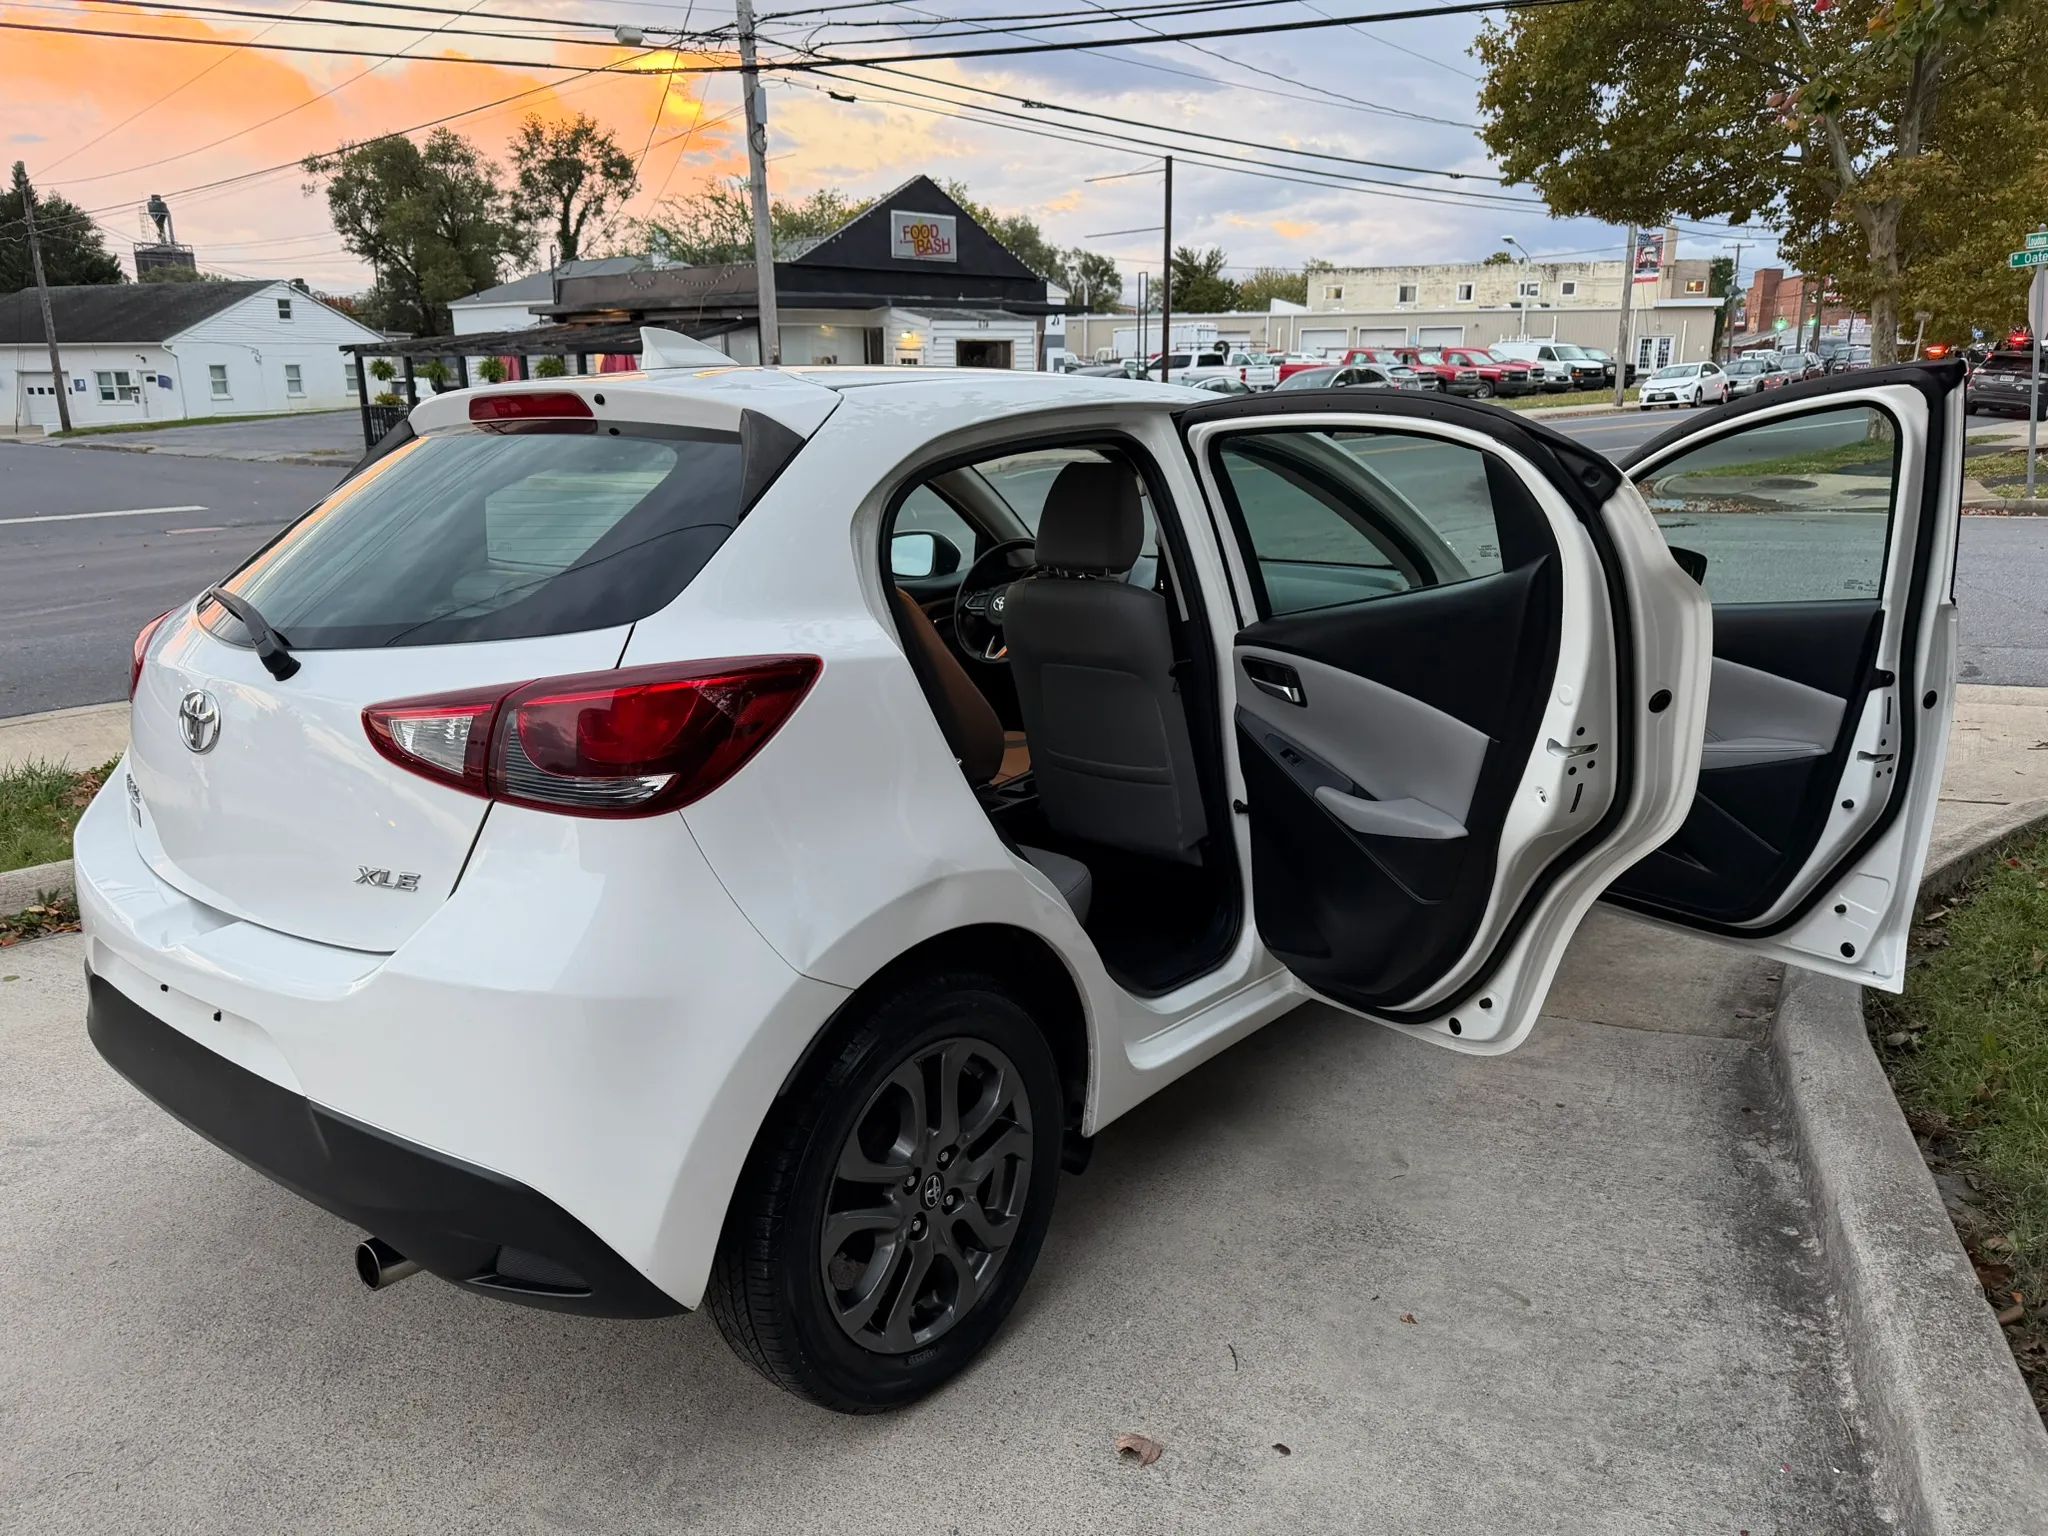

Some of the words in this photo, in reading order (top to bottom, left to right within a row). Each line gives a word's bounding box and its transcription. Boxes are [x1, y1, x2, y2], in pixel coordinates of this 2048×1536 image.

[903, 224, 939, 240] FOOD
[917, 237, 951, 254] BASH
[353, 865, 421, 892] XLE
